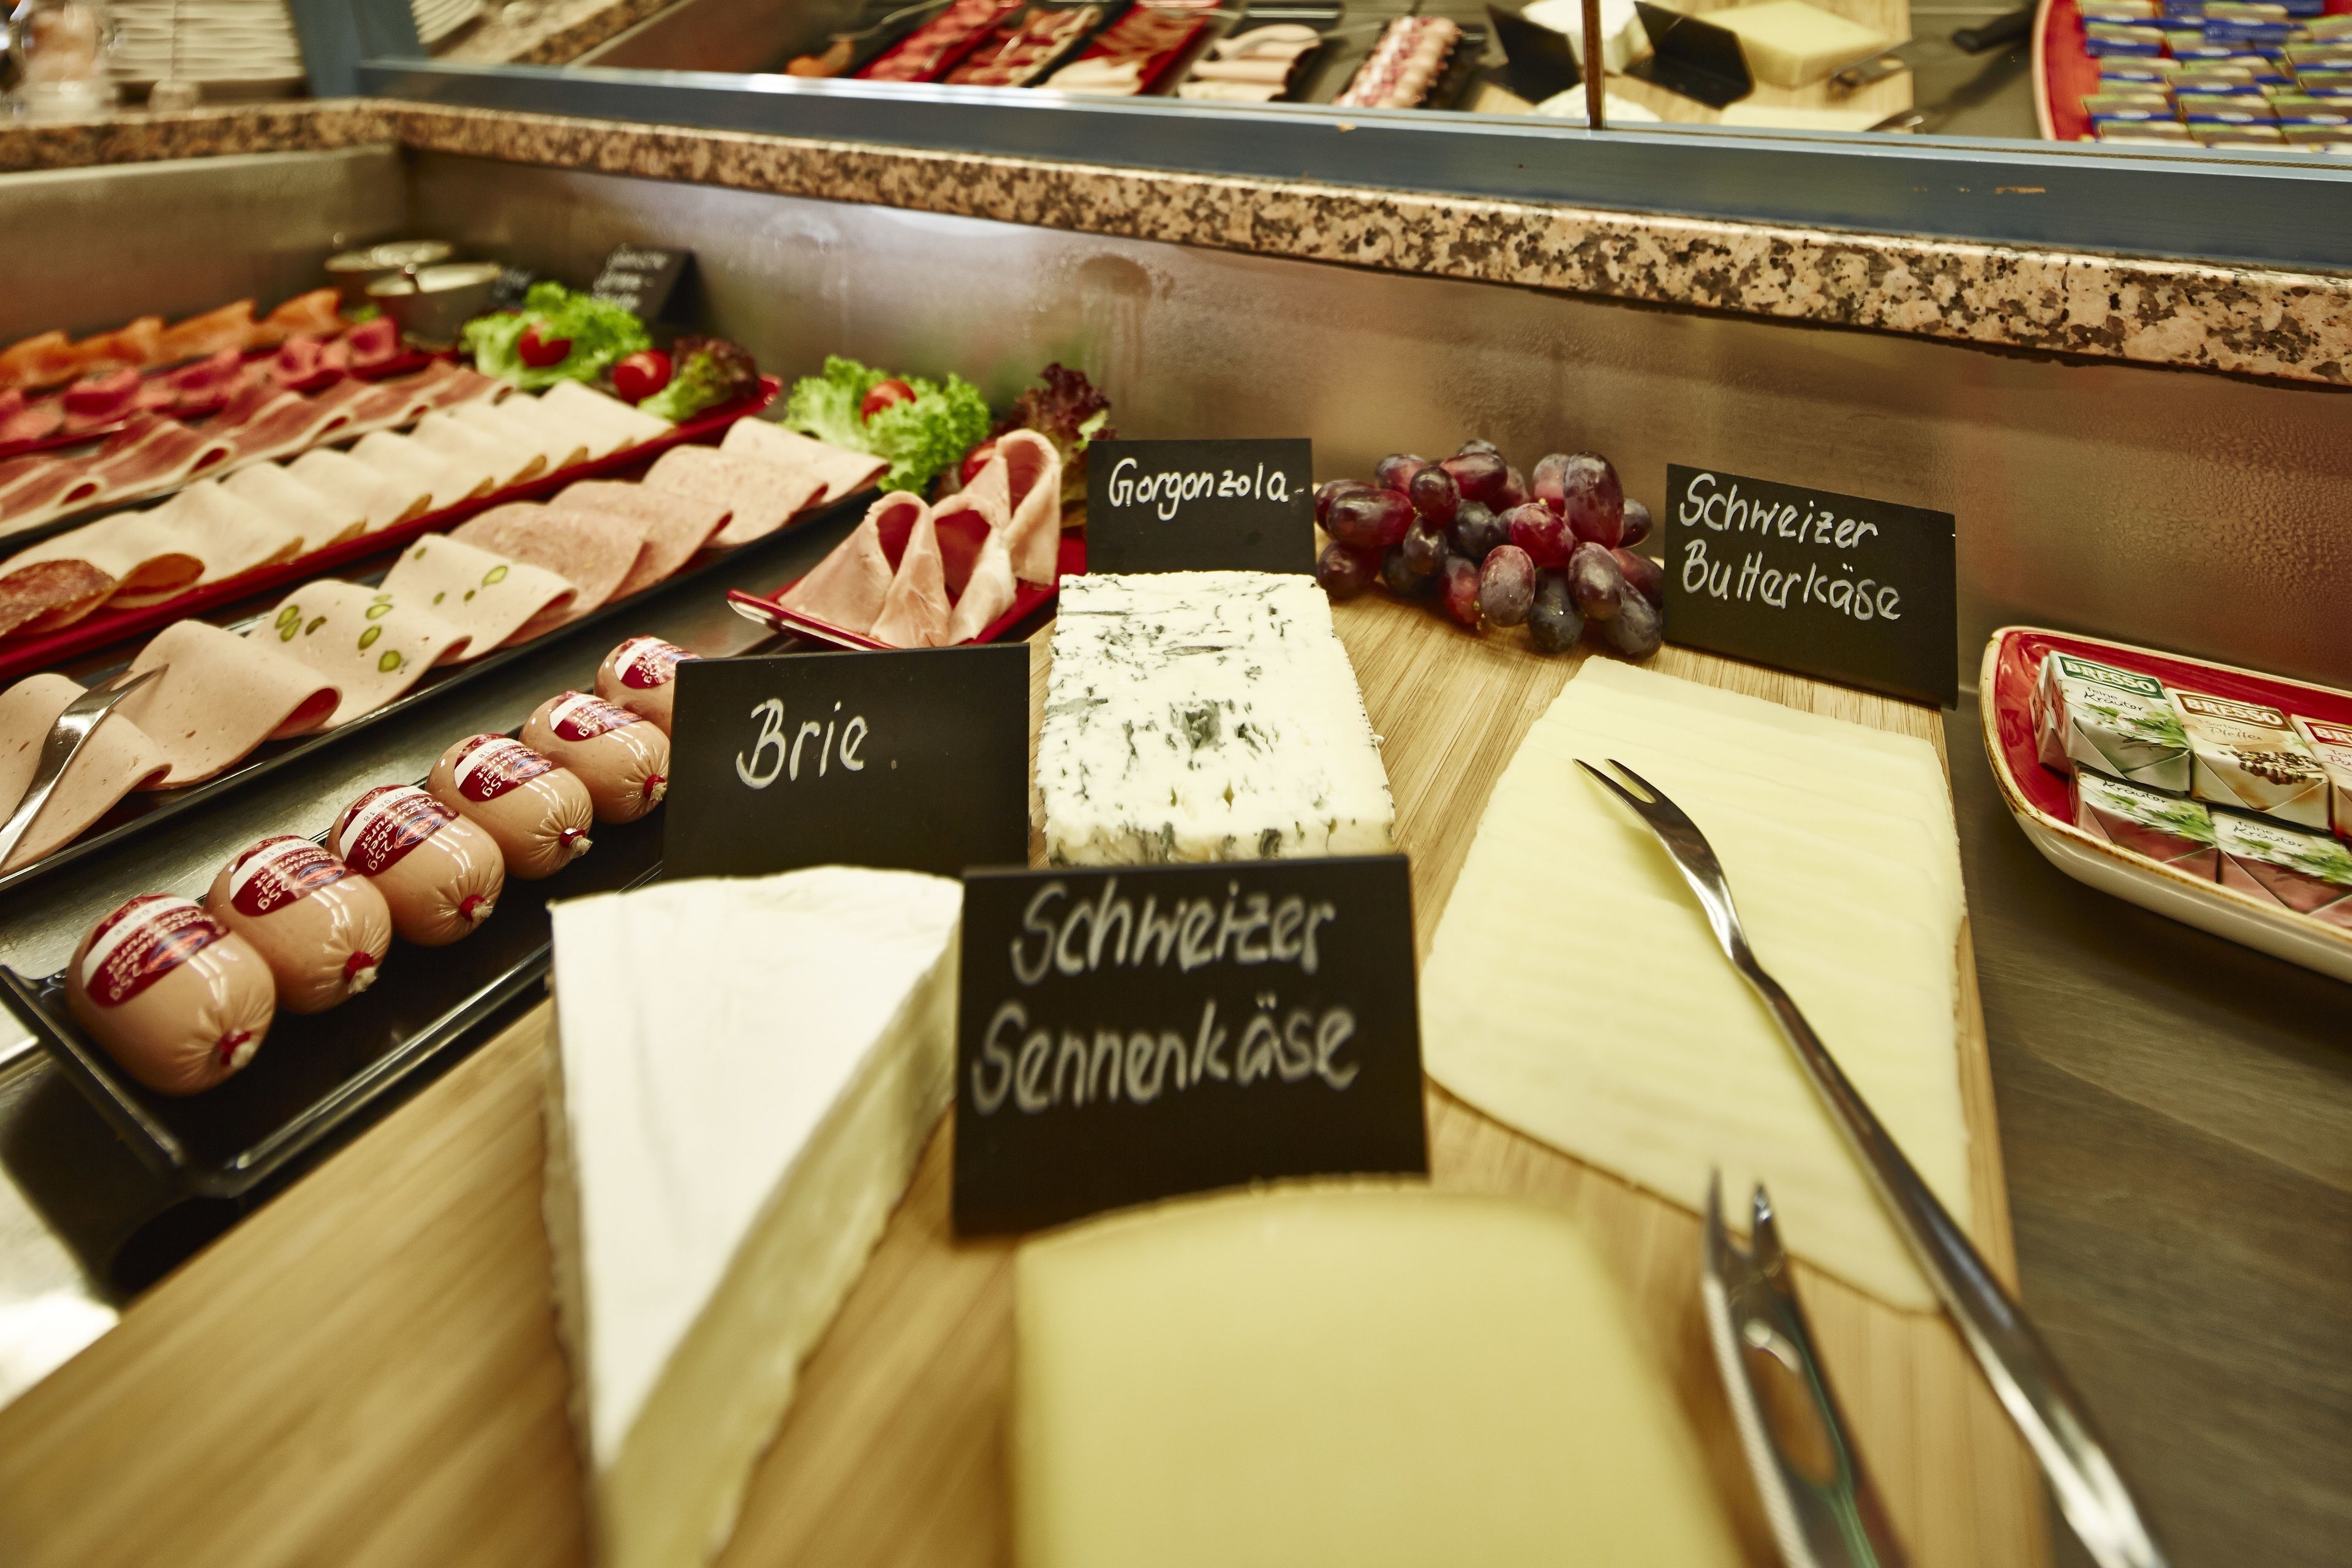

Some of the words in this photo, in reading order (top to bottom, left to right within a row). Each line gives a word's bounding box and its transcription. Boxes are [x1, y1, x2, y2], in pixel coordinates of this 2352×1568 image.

[1109, 458, 1289, 521] Gorgonzola
[1679, 473, 1879, 549] Schweizer
[1683, 539, 1901, 620] Butterkäse
[2063, 660, 2157, 693] BRESSO
[2084, 691, 2146, 711] Kräuter
[2182, 696, 2283, 725] BRESSO
[736, 698, 869, 790] Brie
[2309, 725, 2352, 744] BR
[482, 774, 509, 797] 25g
[2103, 780, 2169, 804] Kräuter
[361, 796, 432, 850] Leberwurst
[366, 801, 443, 859] Röstzwiebel-
[2234, 825, 2304, 848] Kräuter
[368, 841, 393, 871] 25g
[257, 881, 291, 910] 25g
[1011, 877, 1336, 986] Schweizer
[971, 990, 1360, 1115] Sennenkäse
